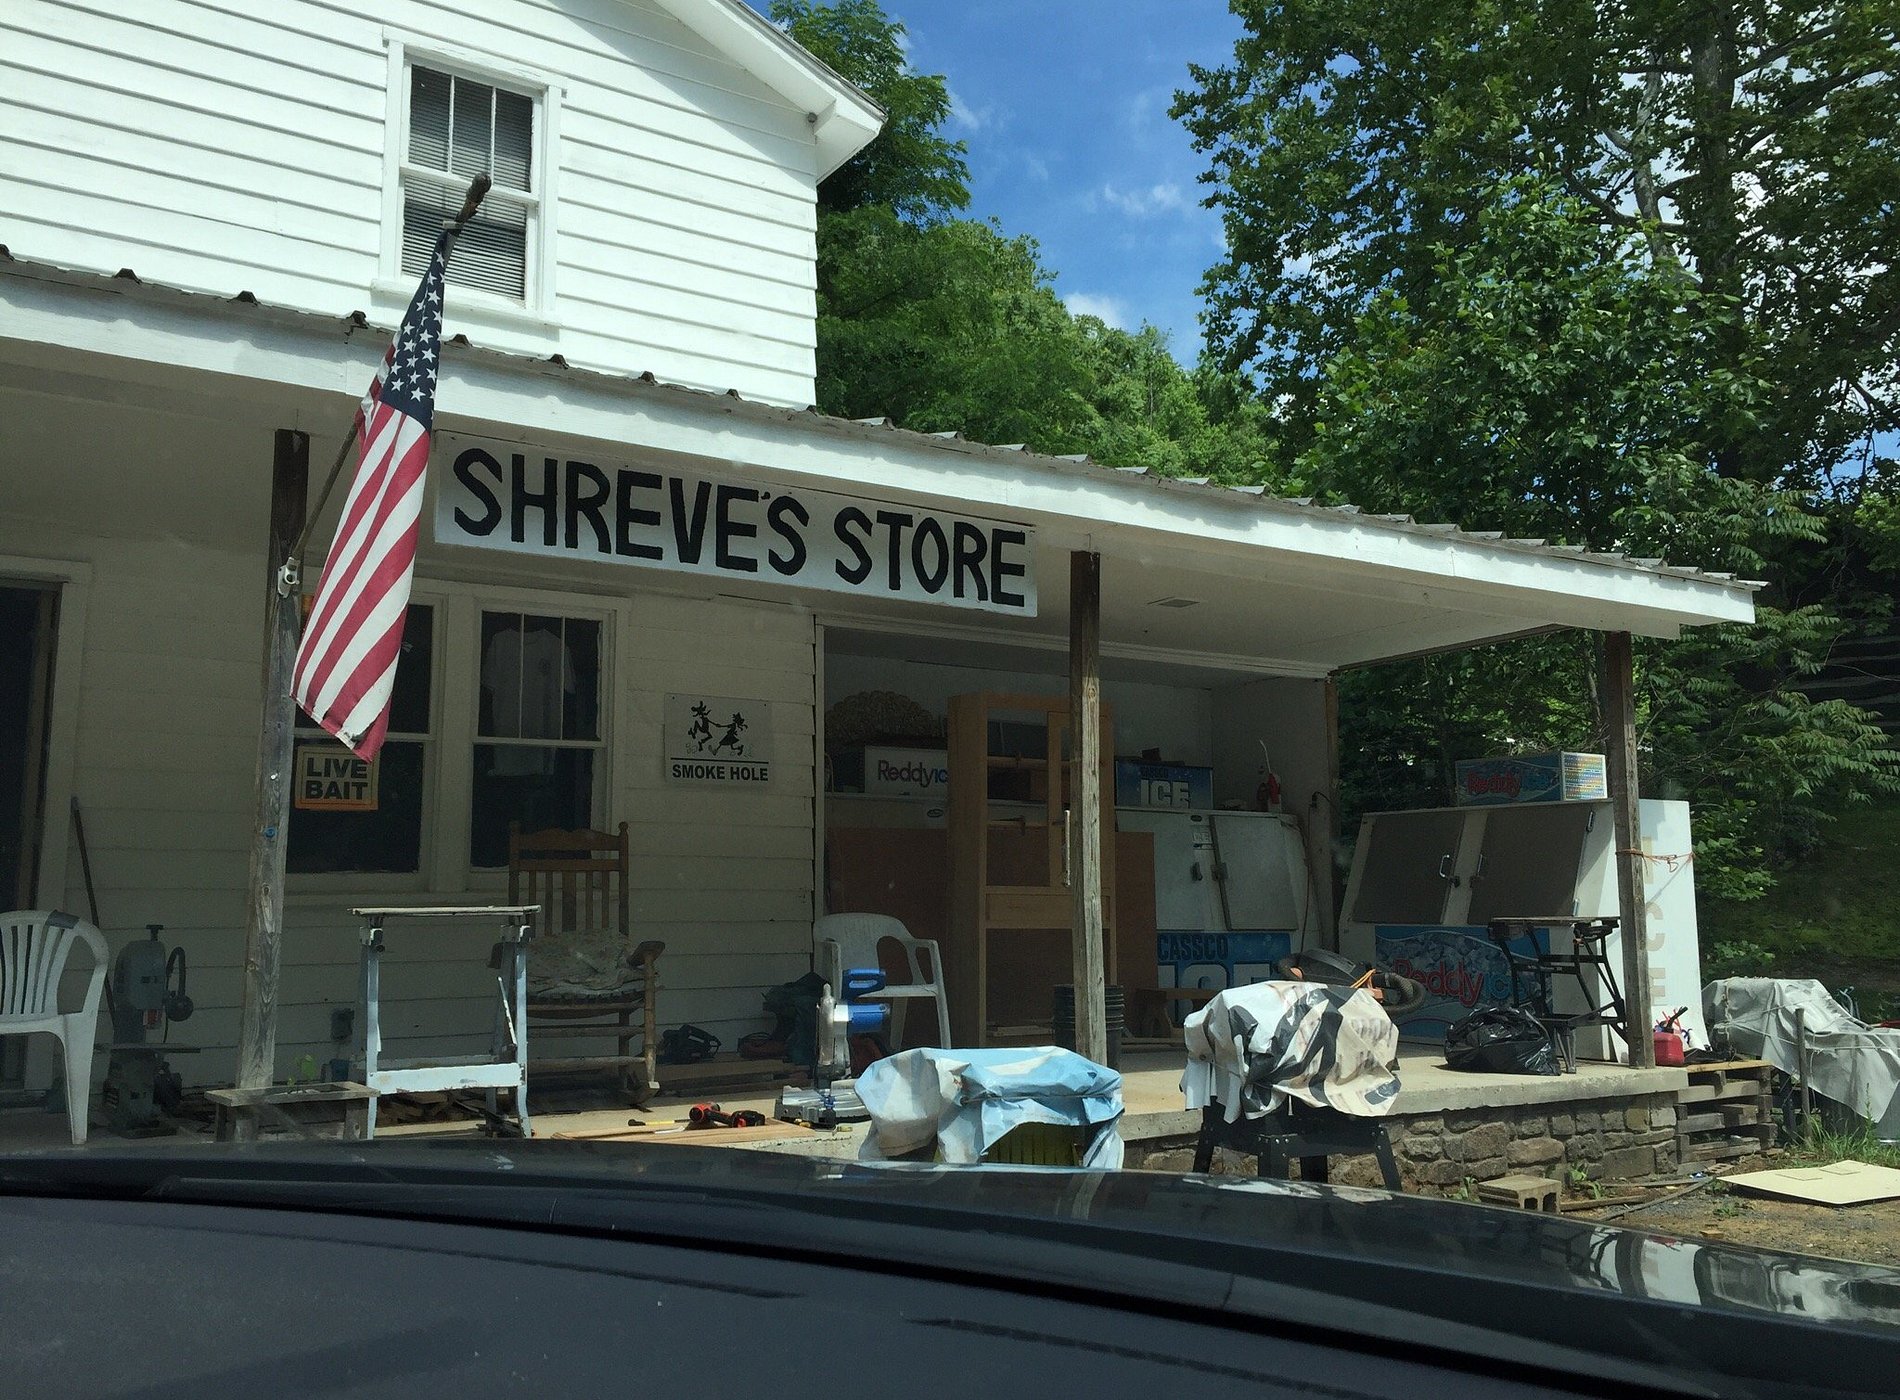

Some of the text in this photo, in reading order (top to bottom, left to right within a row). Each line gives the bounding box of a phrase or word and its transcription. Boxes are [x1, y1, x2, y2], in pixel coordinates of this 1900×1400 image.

[453, 447, 1026, 608] SHREVE'S STORE
[306, 757, 369, 779] LIVE
[672, 763, 769, 782] SMOKE HOLE
[305, 780, 369, 801] BAIT
[1140, 778, 1190, 809] ICE
[1157, 933, 1229, 961] CASSCO
